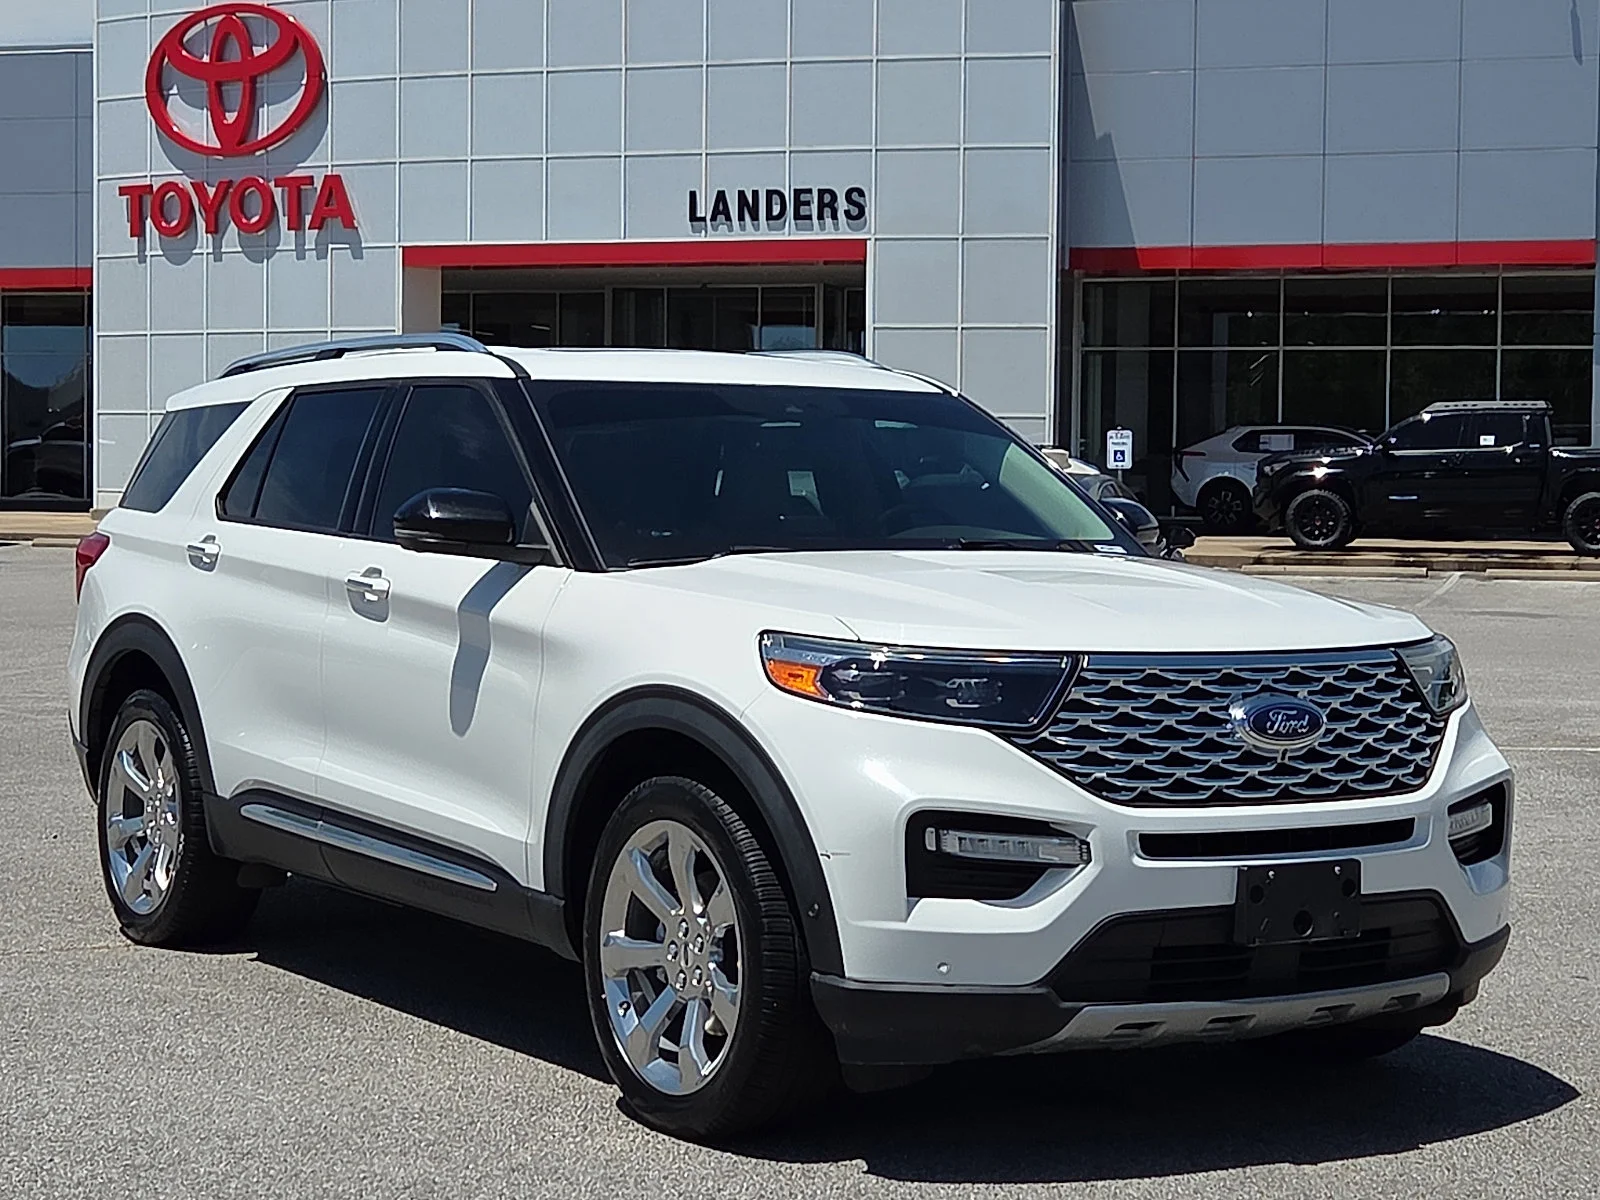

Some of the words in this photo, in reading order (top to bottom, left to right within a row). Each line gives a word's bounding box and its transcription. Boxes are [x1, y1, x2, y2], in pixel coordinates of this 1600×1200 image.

[118, 174, 358, 238] TOYOTA
[689, 187, 867, 223] LANDERS
[1266, 709, 1310, 734] Ford
